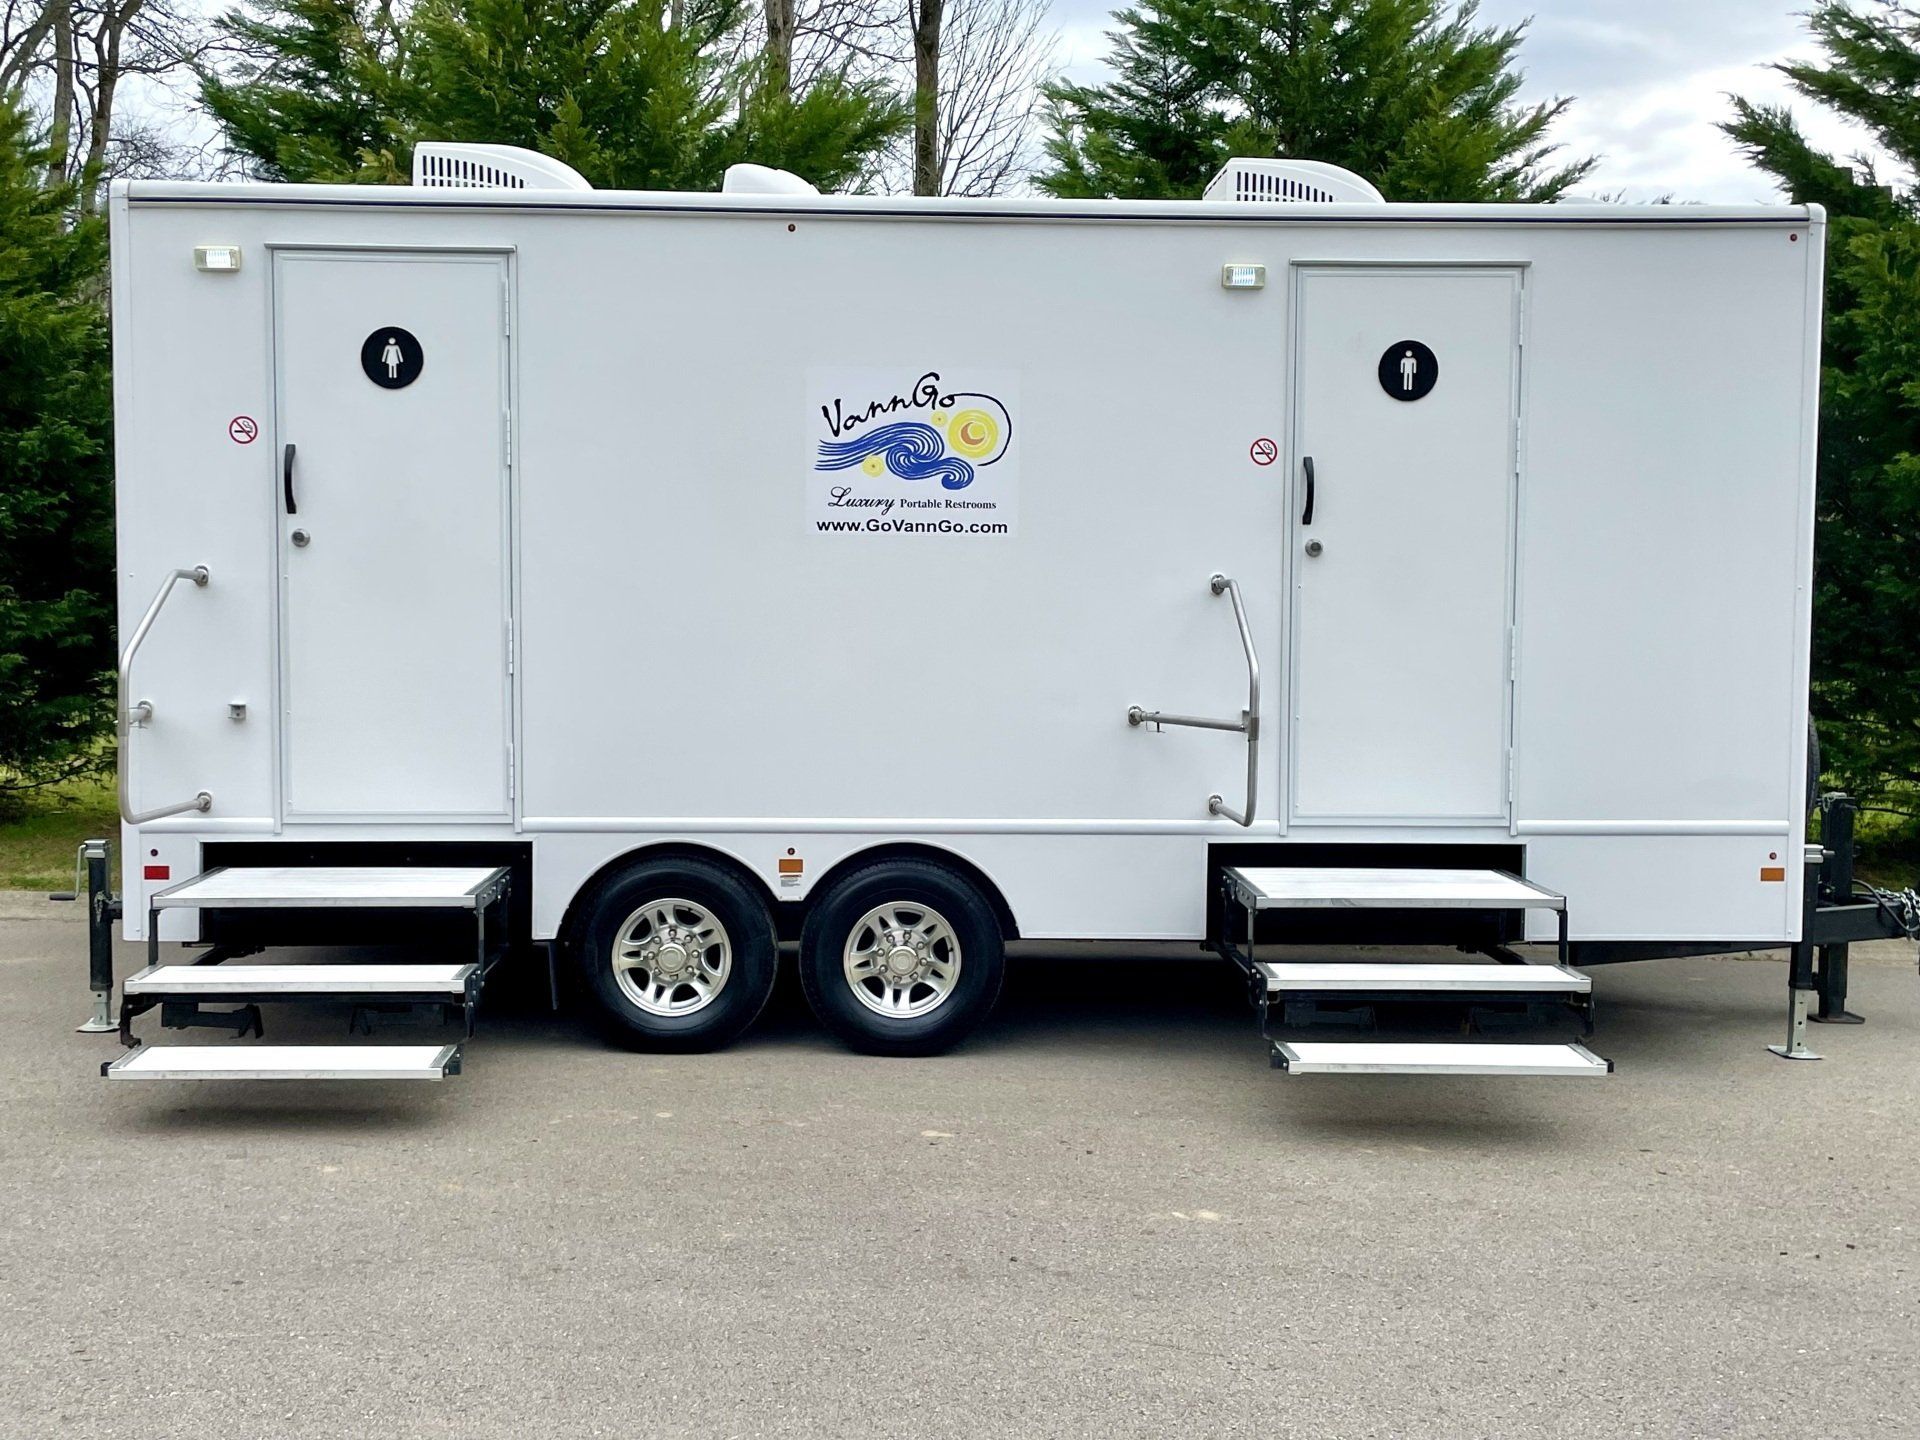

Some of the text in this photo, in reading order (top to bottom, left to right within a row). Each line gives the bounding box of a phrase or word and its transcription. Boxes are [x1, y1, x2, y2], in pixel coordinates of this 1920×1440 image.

[821, 372, 956, 437] VannGo
[828, 486, 997, 515] Luxury Portable Restrooms
[816, 519, 1008, 534] www.GoVannGo.com
